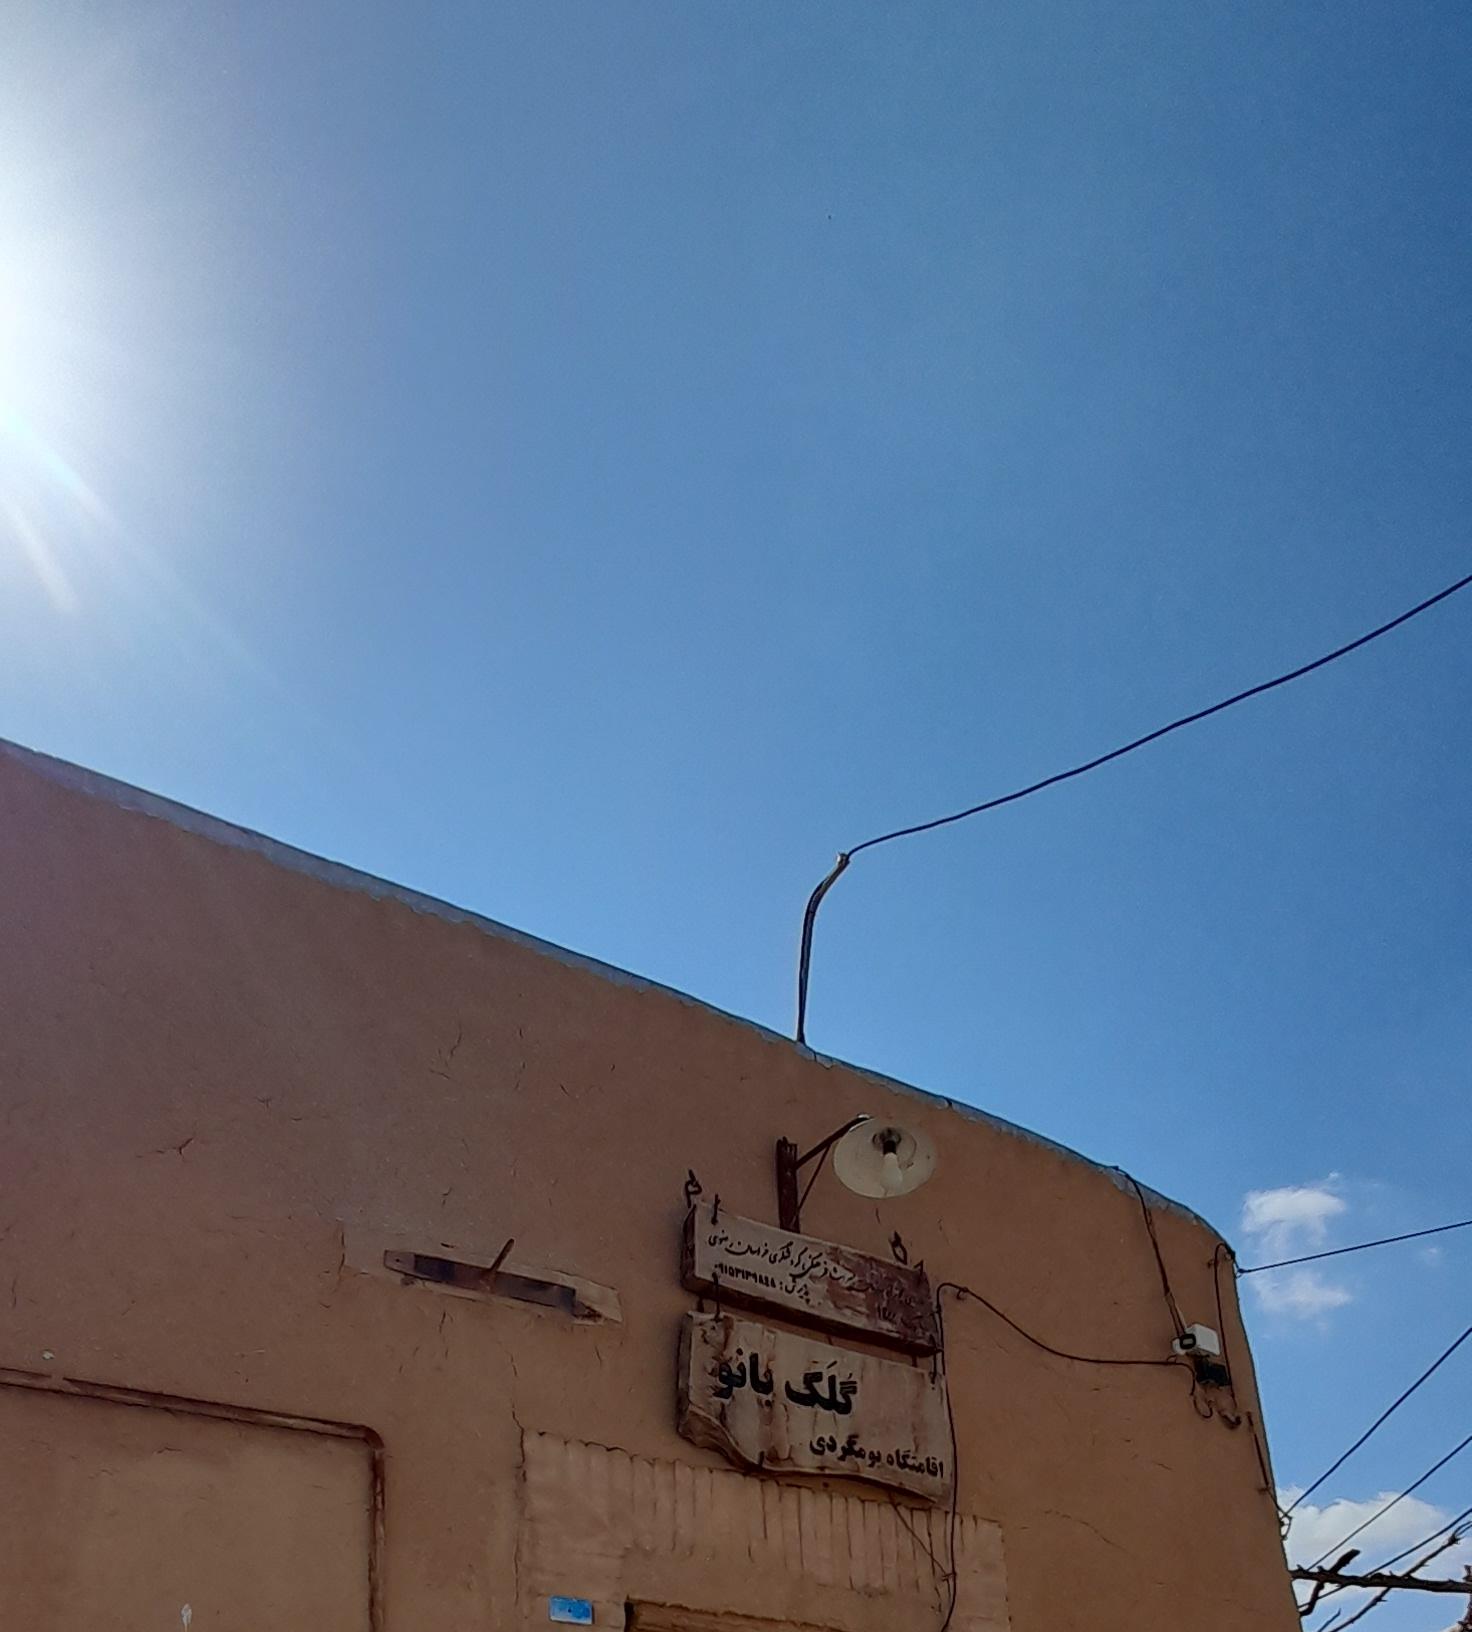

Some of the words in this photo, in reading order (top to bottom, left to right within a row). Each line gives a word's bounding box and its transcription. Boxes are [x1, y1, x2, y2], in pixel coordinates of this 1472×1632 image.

[709, 1230, 733, 1247] رضوی
[725, 1241, 769, 1257] خراسان
[769, 1241, 808, 1267] گردشگری
[713, 1348, 774, 1408] بانو
[886, 1449, 943, 1478] اقامتگاه
